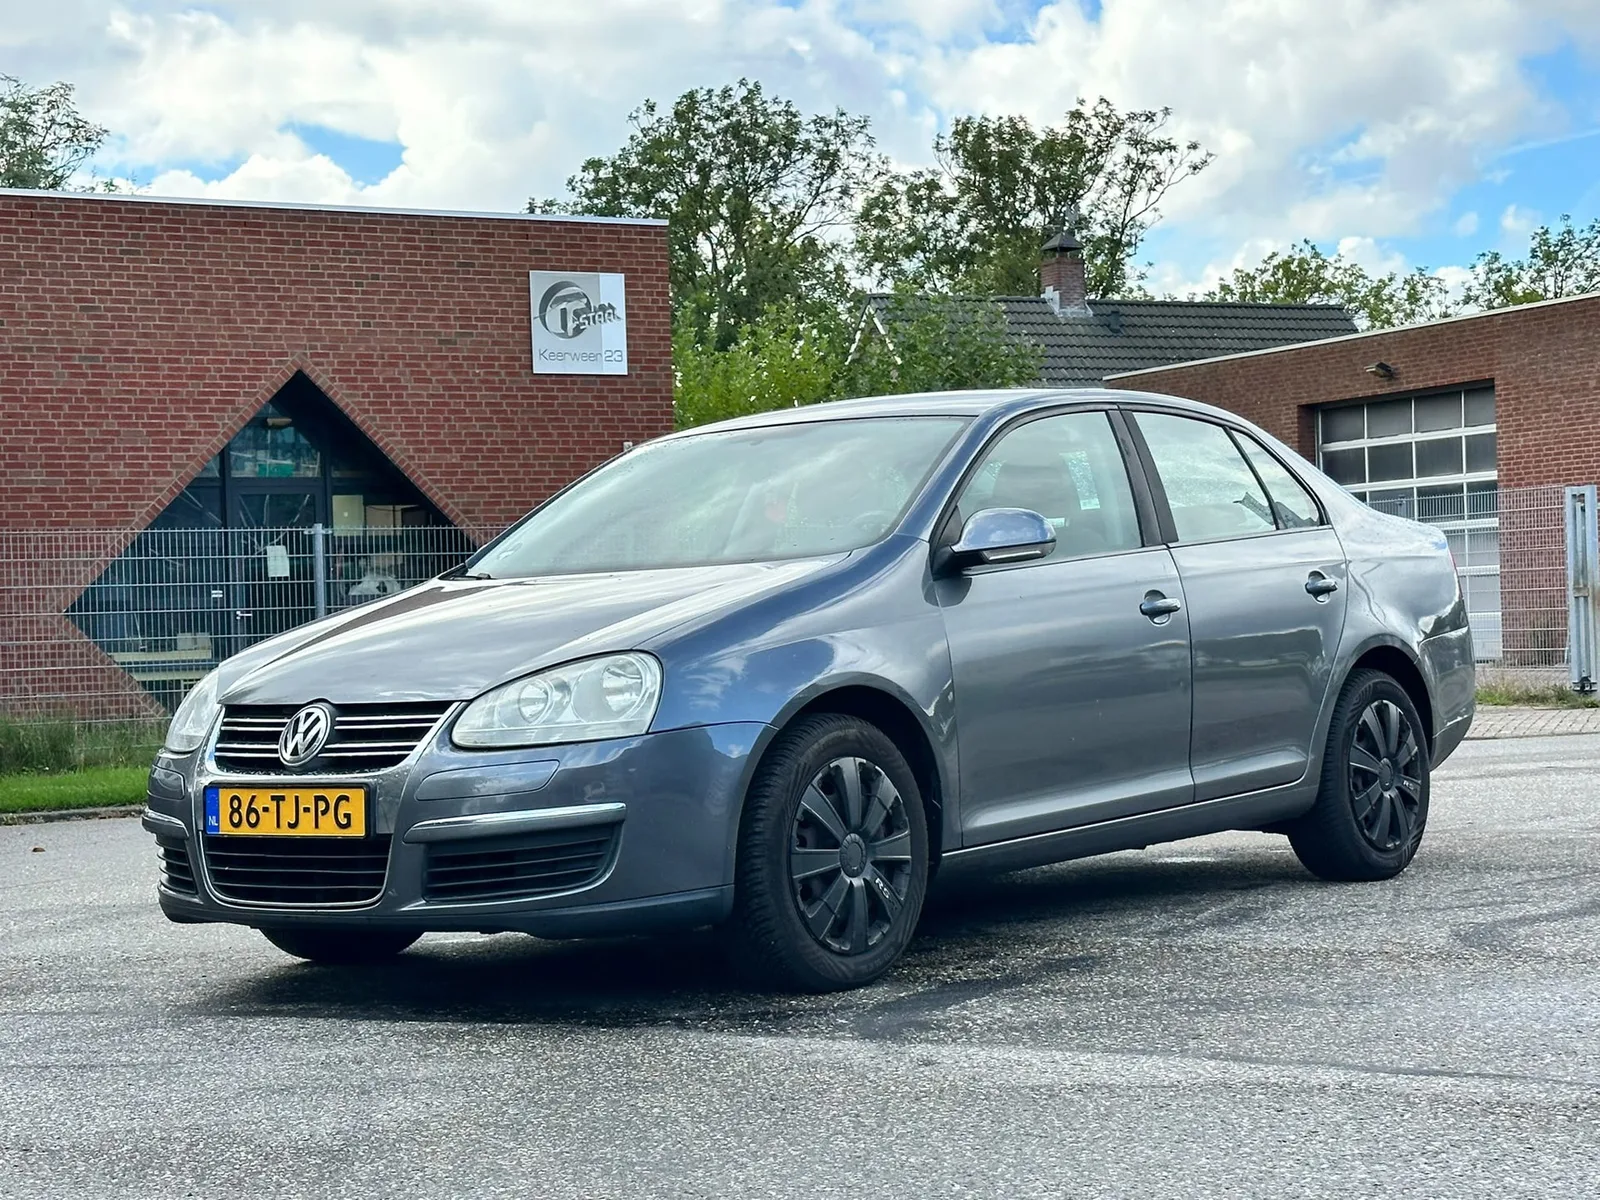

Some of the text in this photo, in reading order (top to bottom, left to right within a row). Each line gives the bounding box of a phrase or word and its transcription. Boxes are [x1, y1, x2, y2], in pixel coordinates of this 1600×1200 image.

[538, 348, 623, 363] Keerweer 23
[228, 794, 352, 830] 86-TJ-PG
[208, 815, 219, 826] NL
